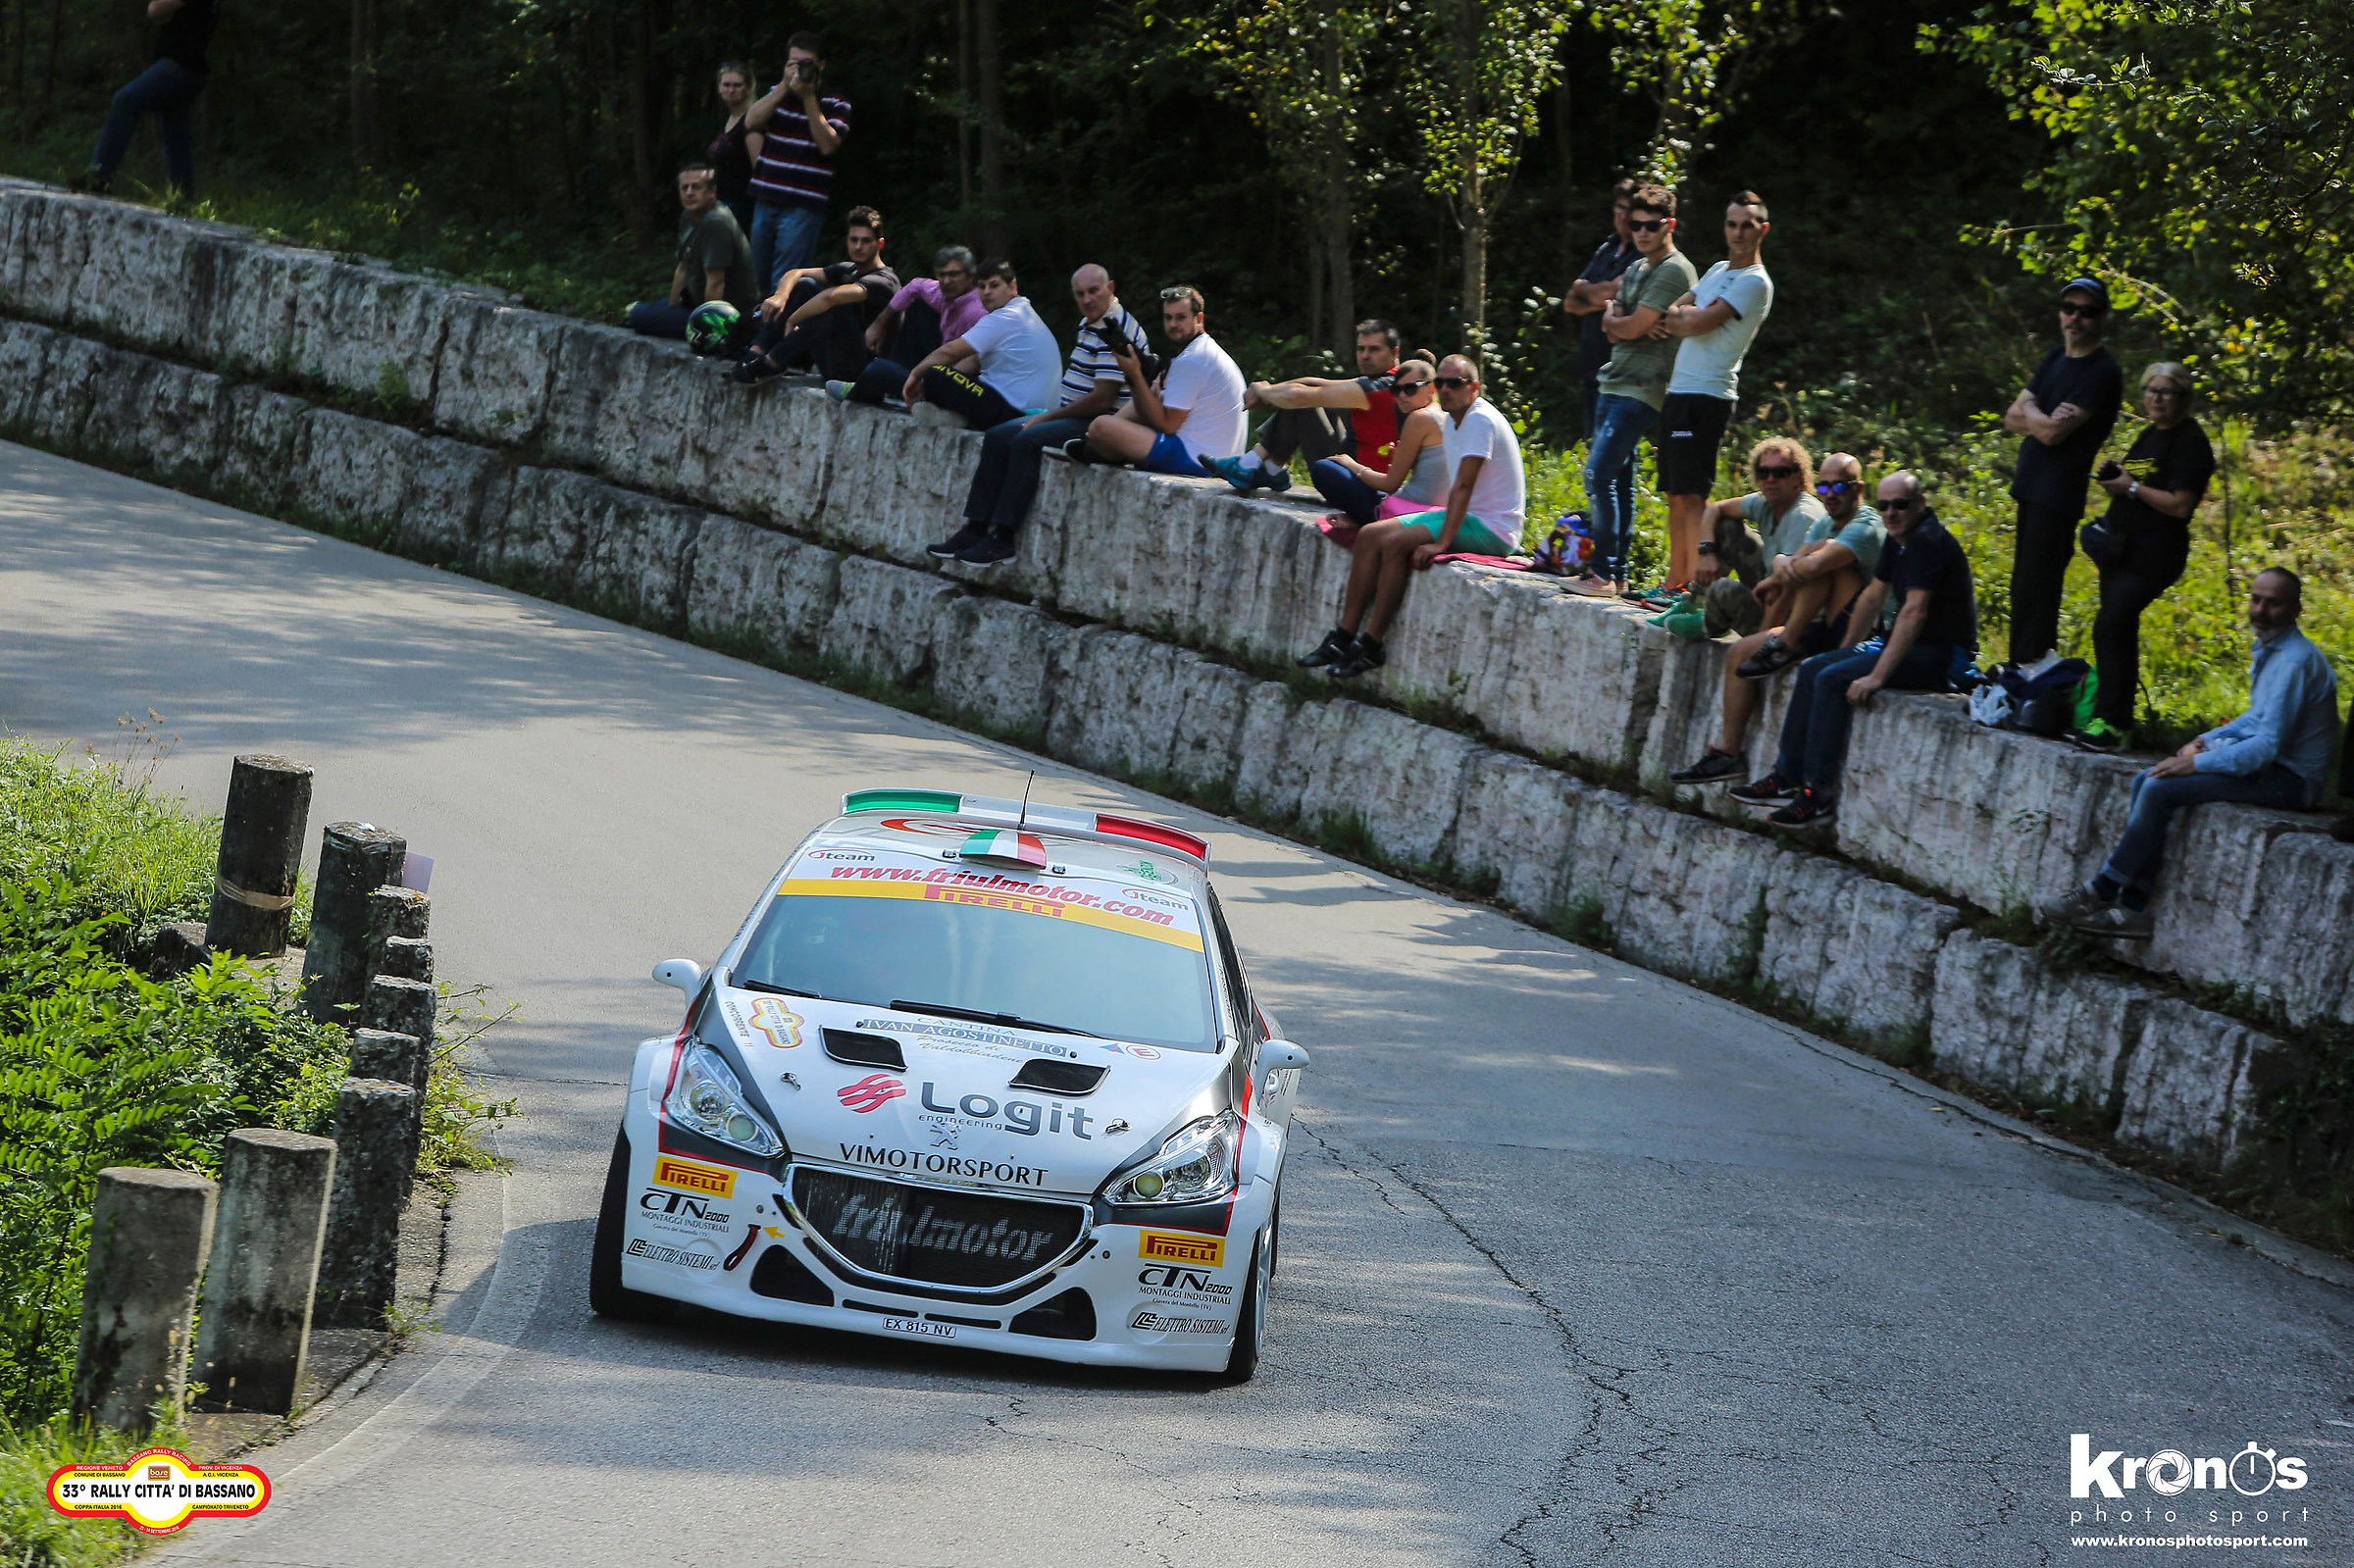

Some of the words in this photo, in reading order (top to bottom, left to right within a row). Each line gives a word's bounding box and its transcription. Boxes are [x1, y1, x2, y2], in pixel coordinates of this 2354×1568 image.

[831, 866, 1174, 925] www.friulmotor.com
[925, 885, 1065, 916] PIRELLI
[725, 1001, 749, 1037] CONCORRENTE
[917, 1017, 1016, 1036] CANTINA
[867, 1020, 914, 1032] IVAN
[924, 1026, 1064, 1055] AGOSTINETTO
[917, 1036, 979, 1048] Prosecco
[918, 1114, 1002, 1130] engineering
[921, 1082, 1094, 1140] Logit
[840, 1142, 1049, 1187] VIMOTORSPORT
[660, 1162, 729, 1192] PIRELLI
[641, 1212, 683, 1225] MONTAGGI
[685, 1219, 730, 1233] INDUSTRIALI
[706, 1212, 730, 1223] 2000
[643, 1244, 679, 1263] ELETTRO
[677, 1251, 714, 1269] SISTEMI
[1147, 1236, 1218, 1261] PIRELLI
[1139, 1287, 1182, 1297] MONTAGGI
[1185, 1291, 1231, 1305] INDUSTRIALI
[1204, 1284, 1233, 1294] 2000
[887, 1319, 902, 1329] EX
[906, 1321, 928, 1332] 815
[934, 1325, 951, 1335] NV
[1152, 1317, 1192, 1333] ELETTRO
[1191, 1320, 1225, 1334] SISTEMI
